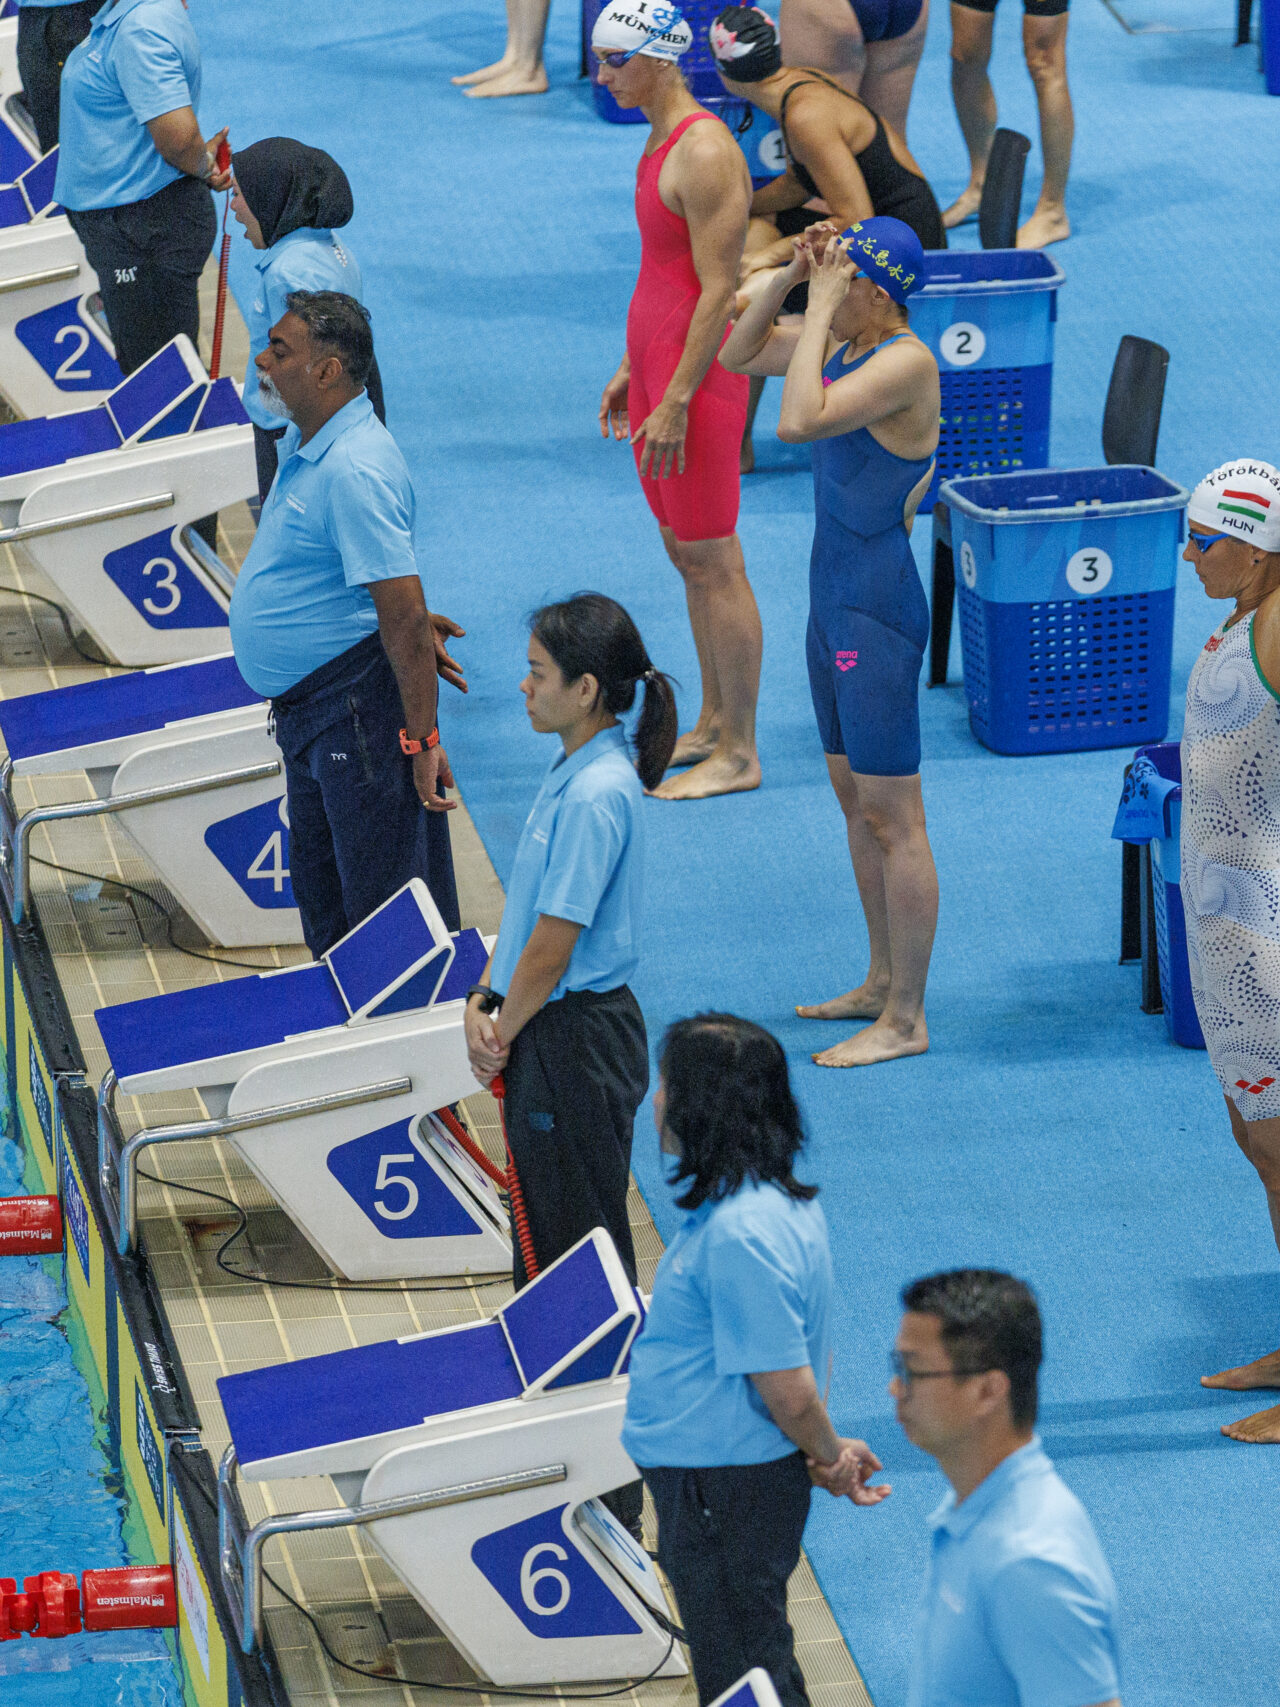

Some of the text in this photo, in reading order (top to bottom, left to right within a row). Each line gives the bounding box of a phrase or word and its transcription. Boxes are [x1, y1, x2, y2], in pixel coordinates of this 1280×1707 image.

[637, 2, 648, 13] I
[774, 137, 785, 159] 1
[54, 324, 92, 380] 2
[956, 330, 972, 354] 2
[1221, 516, 1255, 535] HUN
[1082, 556, 1099, 582] 3
[142, 556, 182, 616] 3
[331, 753, 347, 761] TYR
[247, 830, 292, 892] 4
[373, 1153, 419, 1221] 5
[520, 1542, 571, 1616] 6
[96, 1594, 151, 1606] Malmsten
